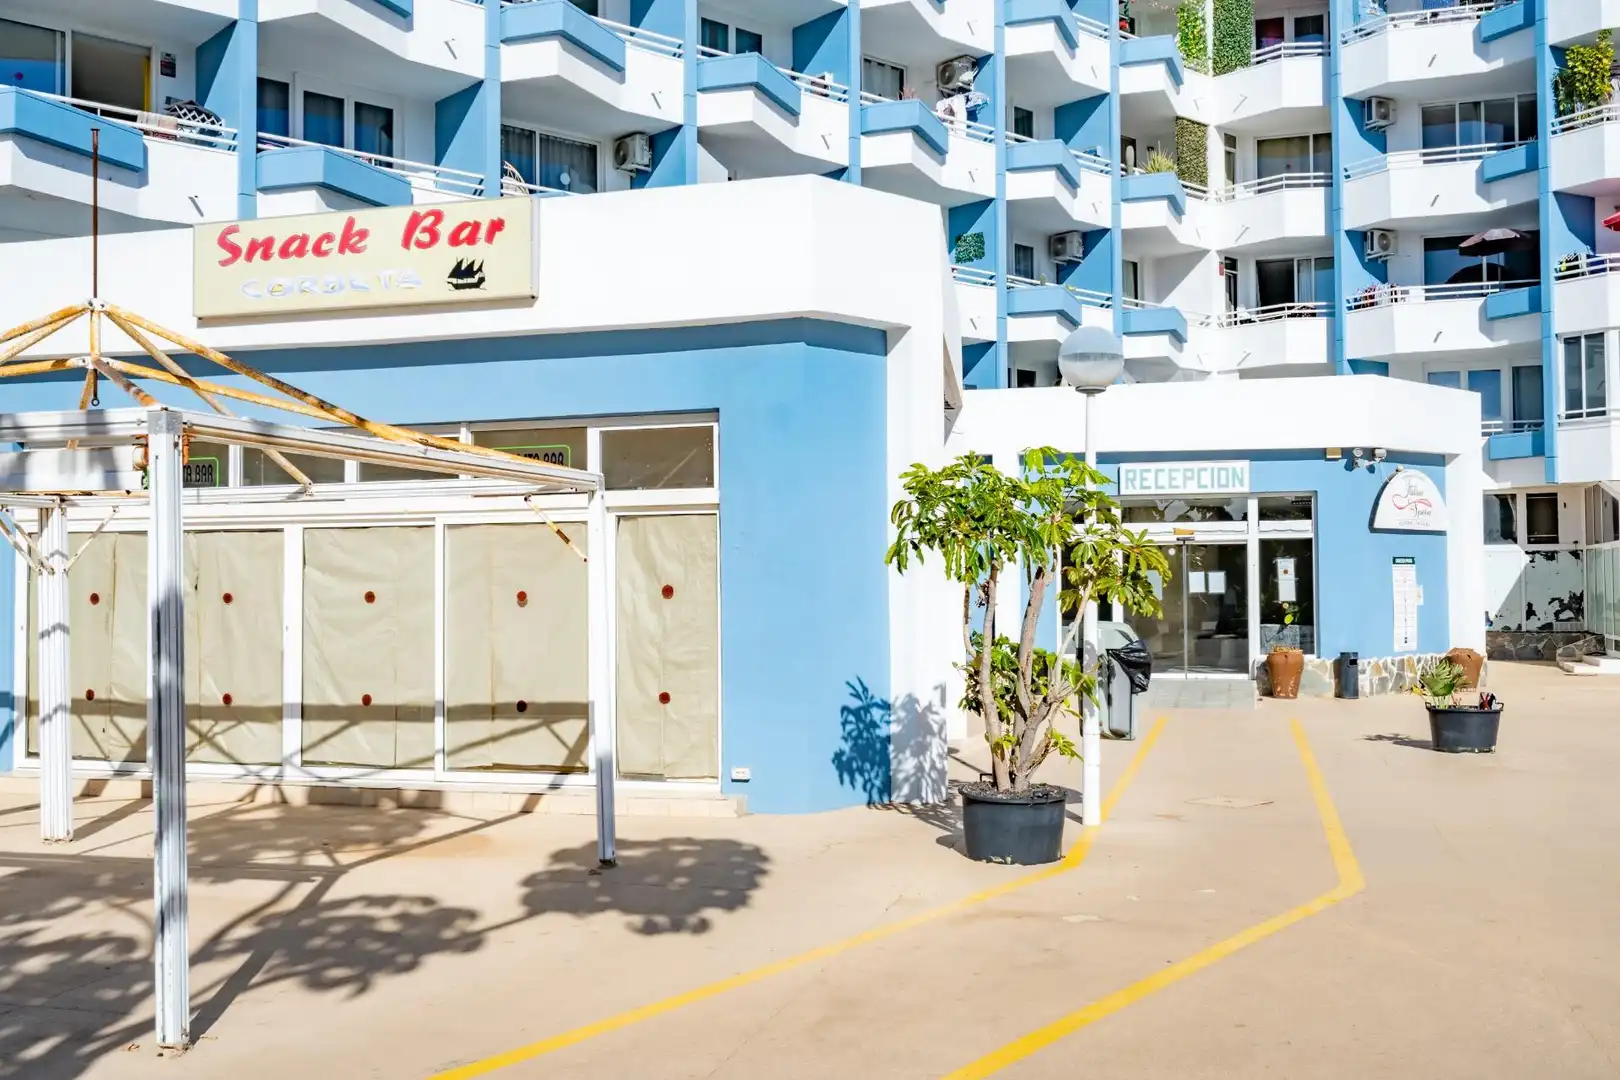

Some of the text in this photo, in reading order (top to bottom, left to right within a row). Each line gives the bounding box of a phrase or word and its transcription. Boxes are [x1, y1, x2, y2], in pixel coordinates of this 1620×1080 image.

[216, 208, 506, 268] Snack Bar
[194, 463, 214, 483] BAR
[1124, 466, 1245, 491] RECEPCION
